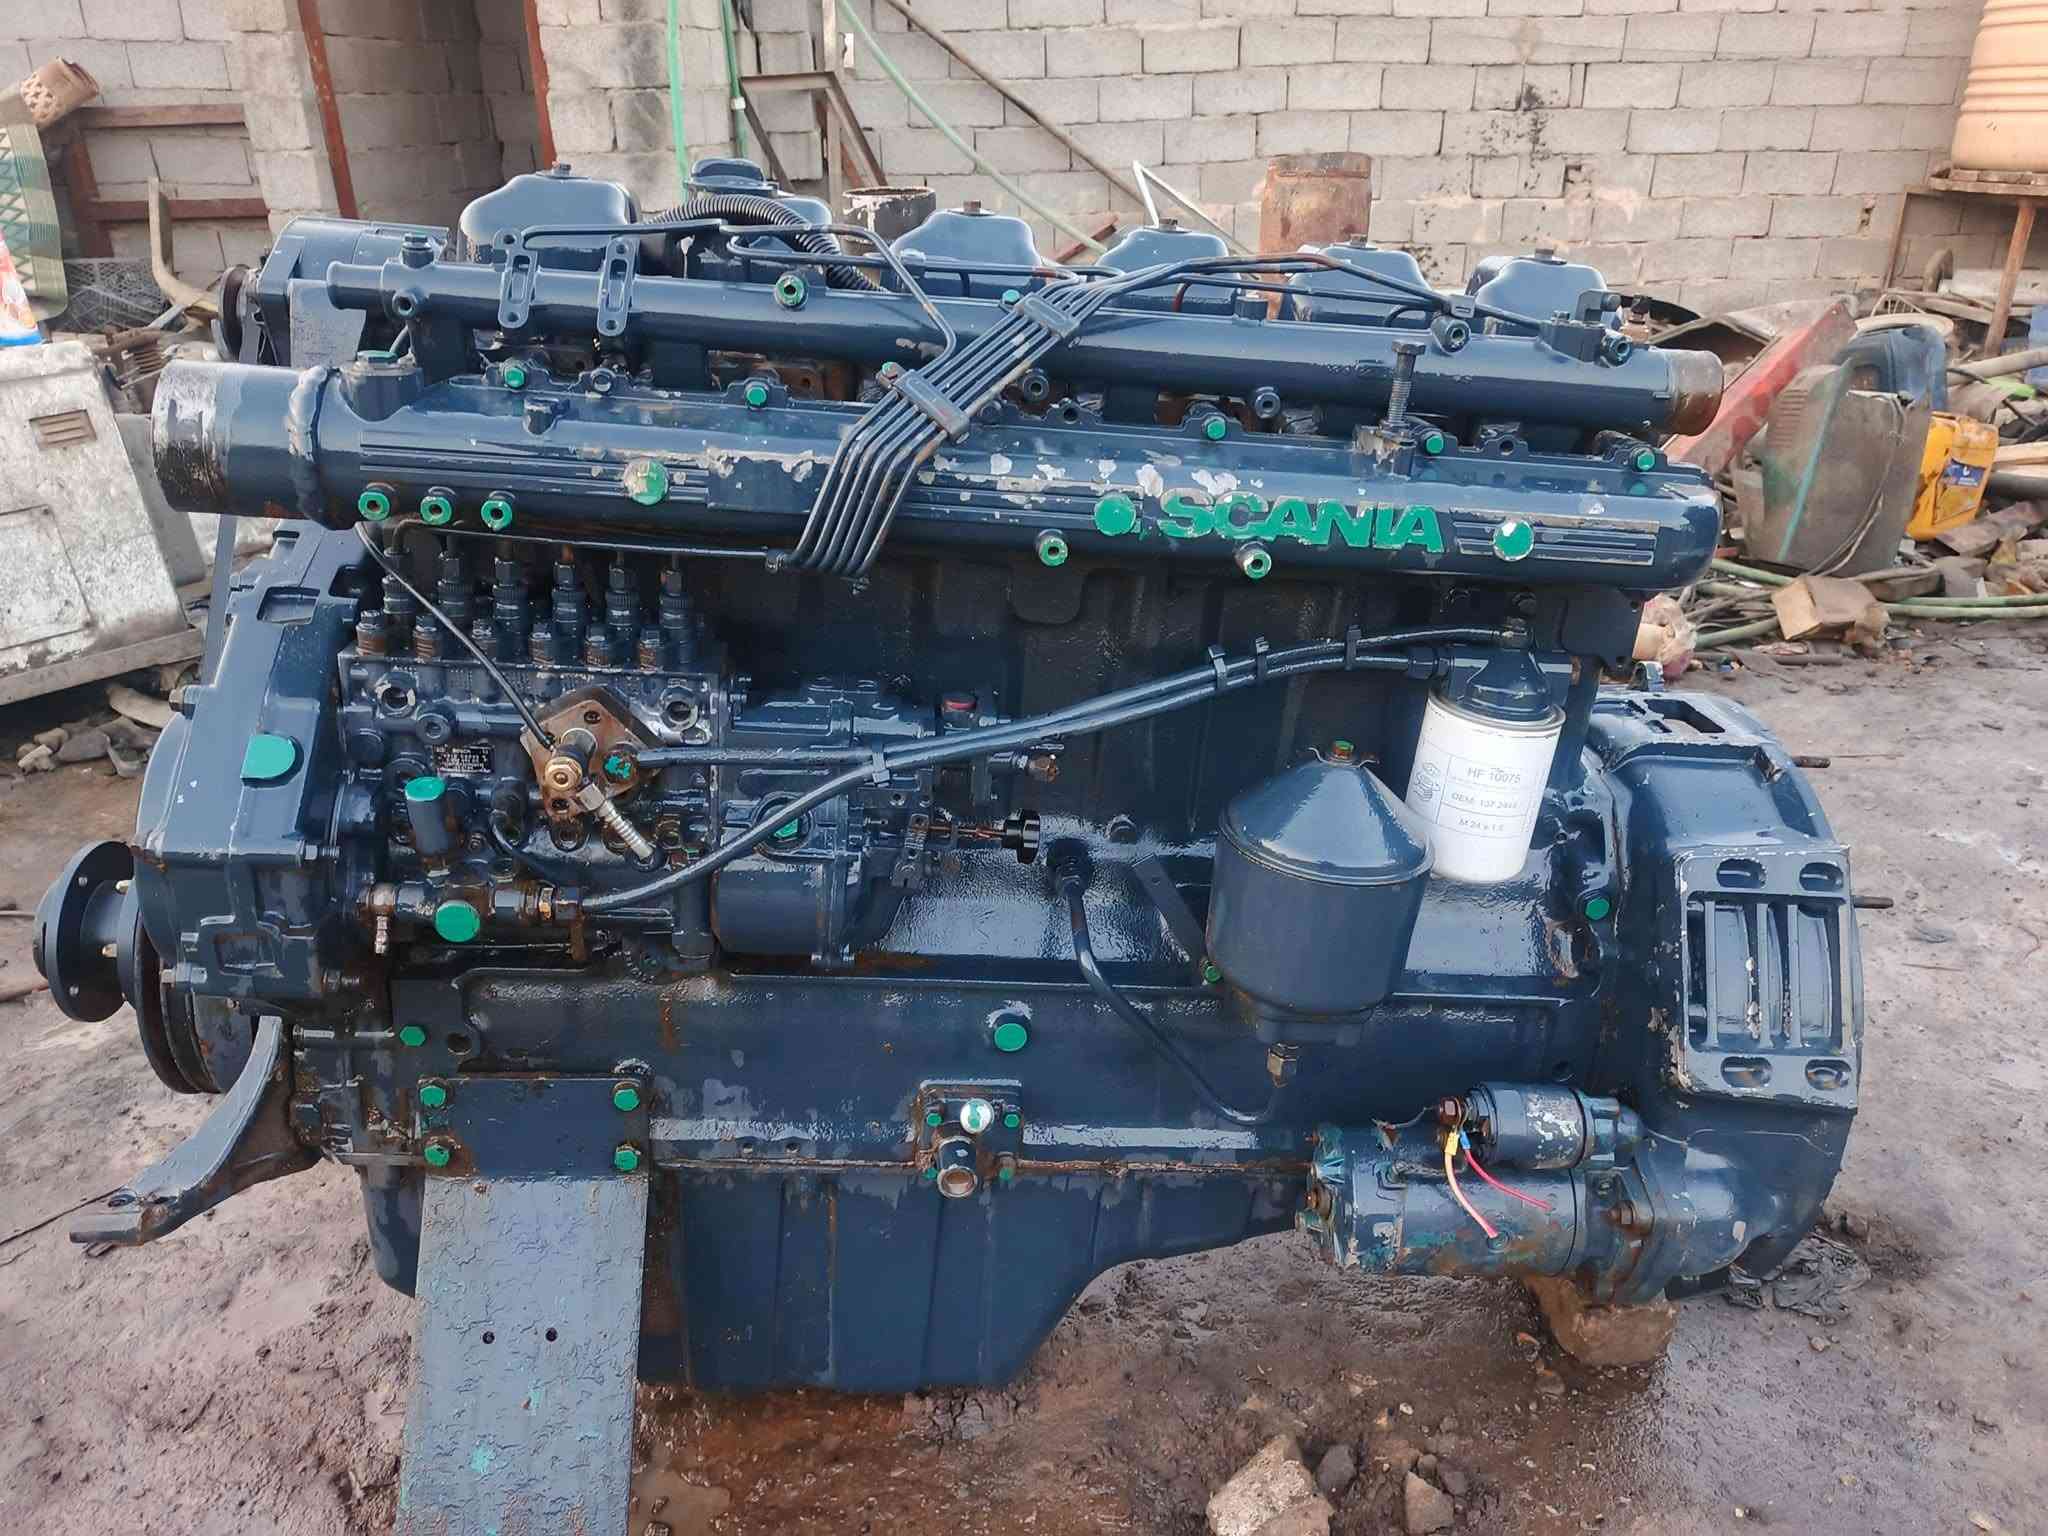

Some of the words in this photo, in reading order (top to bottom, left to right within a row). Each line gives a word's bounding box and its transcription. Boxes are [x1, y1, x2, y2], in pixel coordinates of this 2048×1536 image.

[1157, 487, 1446, 553] SCANIA
[1467, 766, 1485, 778] HF
[1488, 771, 1521, 784] 10075
